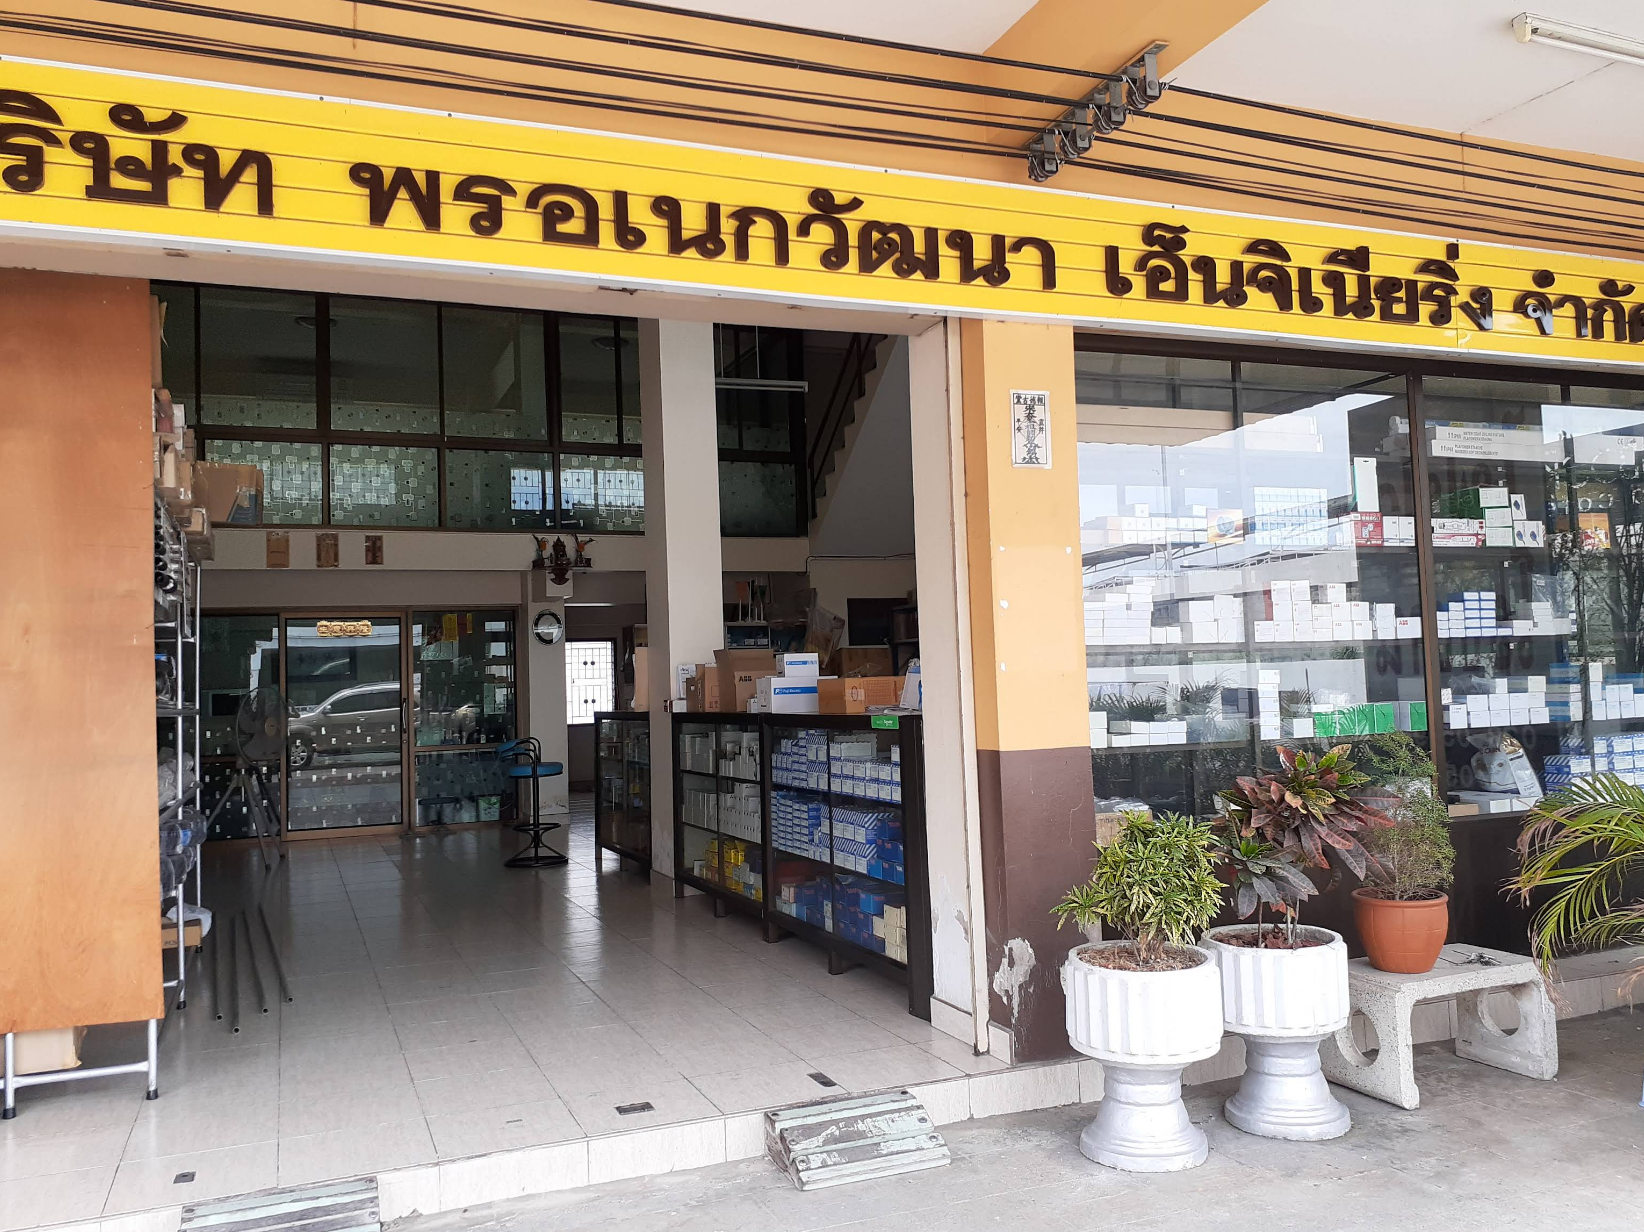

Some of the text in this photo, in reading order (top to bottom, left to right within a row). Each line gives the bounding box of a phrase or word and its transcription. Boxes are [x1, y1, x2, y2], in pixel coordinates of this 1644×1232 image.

[348, 161, 1057, 291] พรอเนกวัฒนา
[1104, 221, 1494, 331] เอ็นจิเนียริ่ง
[738, 675, 752, 683] ABB
